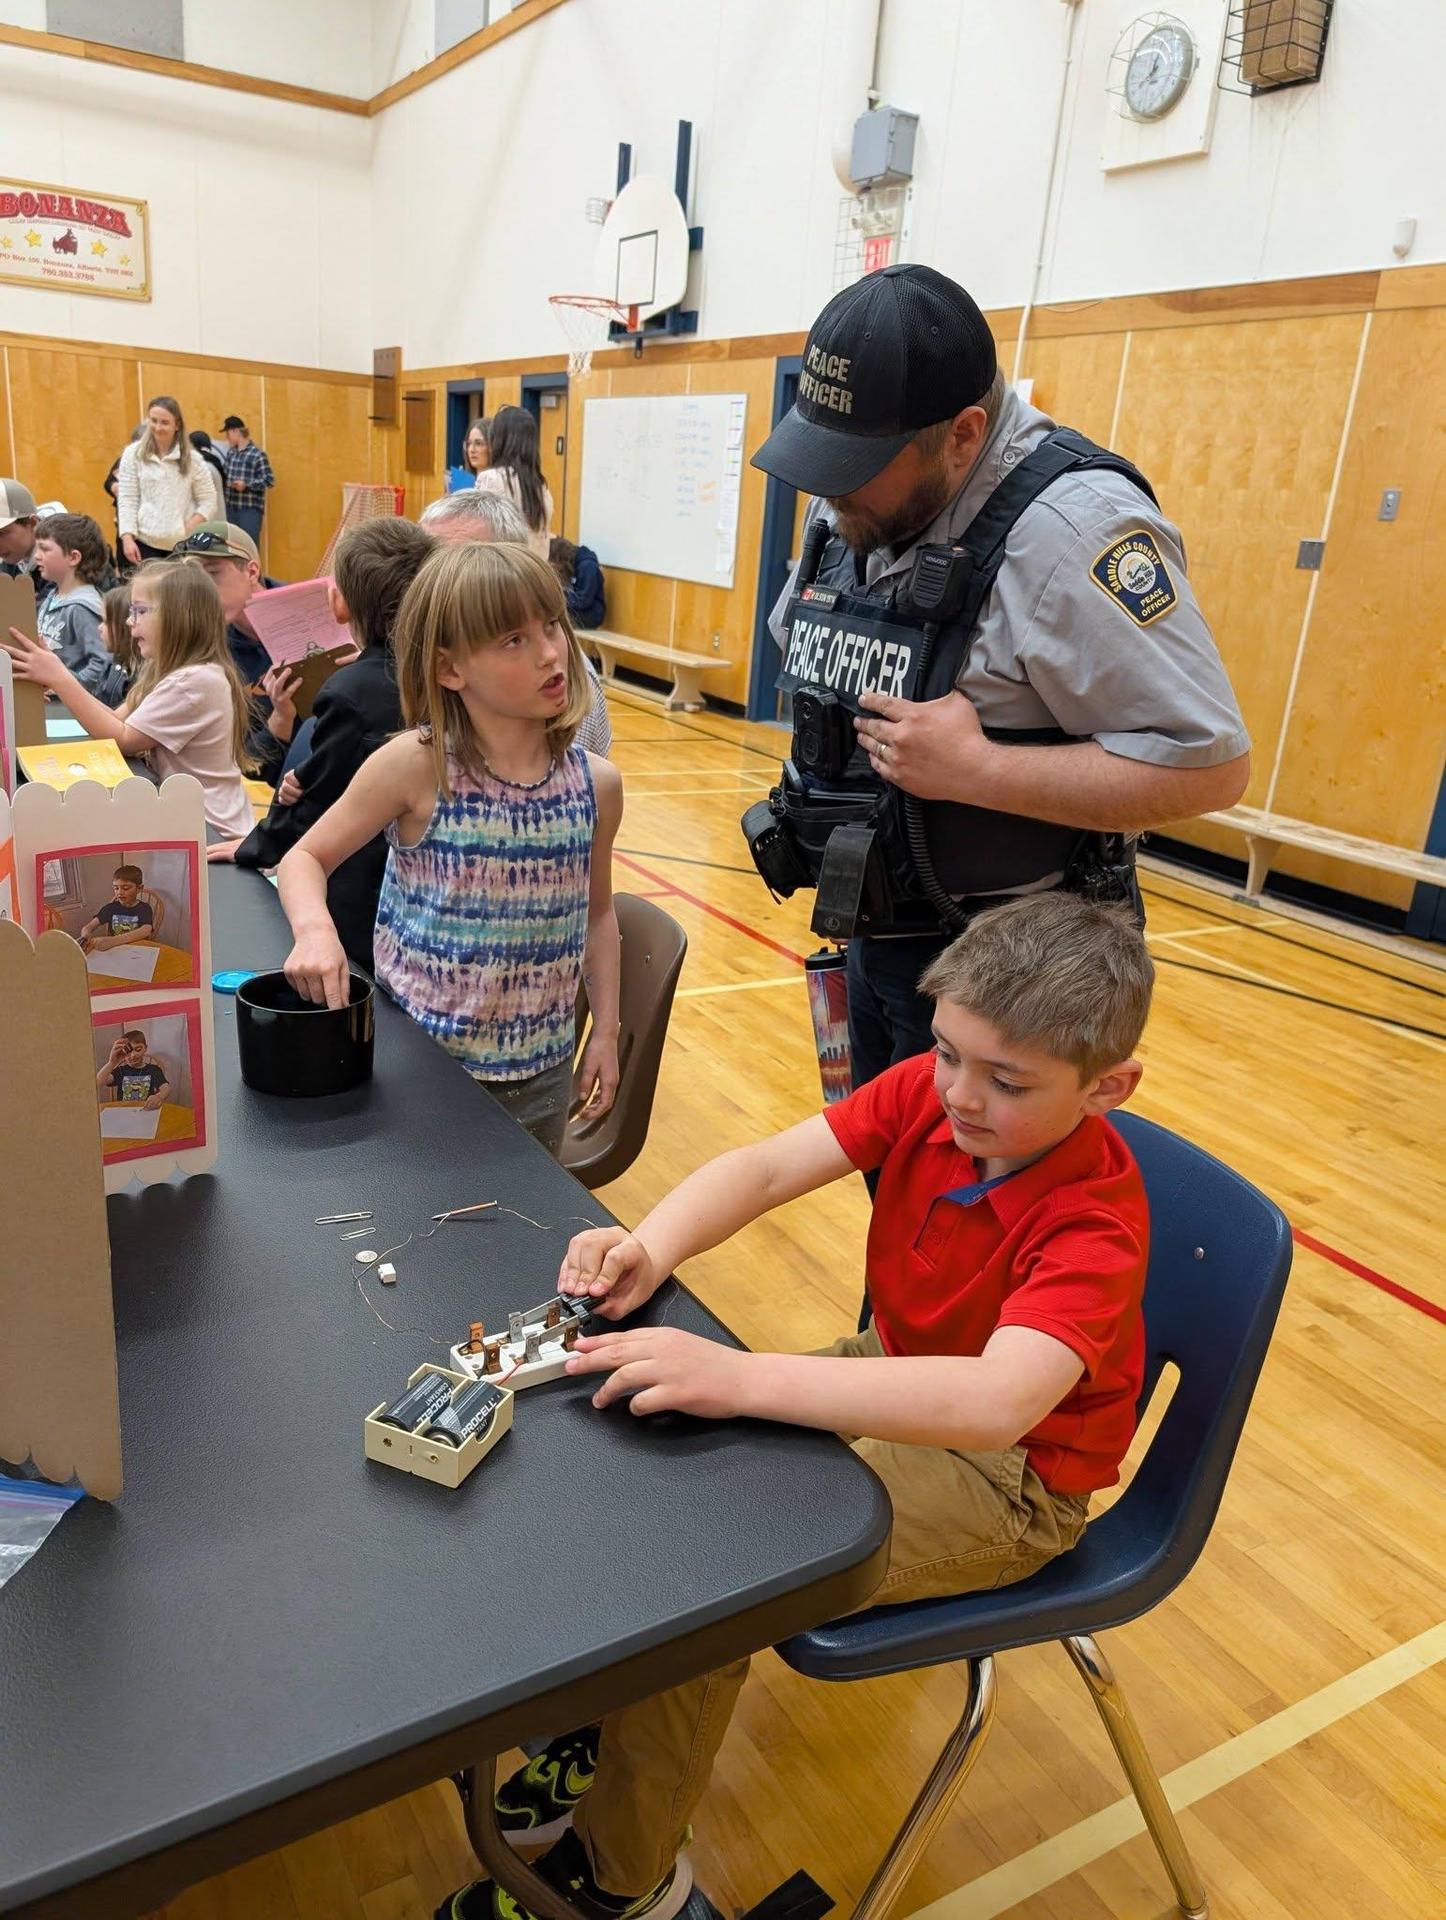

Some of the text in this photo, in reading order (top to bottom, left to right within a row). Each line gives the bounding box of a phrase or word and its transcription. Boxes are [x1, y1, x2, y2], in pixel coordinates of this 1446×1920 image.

[0, 191, 133, 238] BONANZA
[807, 344, 851, 382] PEACE
[800, 370, 853, 414] OFFICER
[1112, 541, 1132, 560] HILLS
[1133, 541, 1161, 565] COUNTY
[1140, 587, 1164, 607] PEACE
[1141, 593, 1171, 617] OFFICER
[784, 619, 911, 699] PEACE OFFICER
[416, 1387, 452, 1423] PROCELL
[460, 1400, 497, 1439] PROCELL
